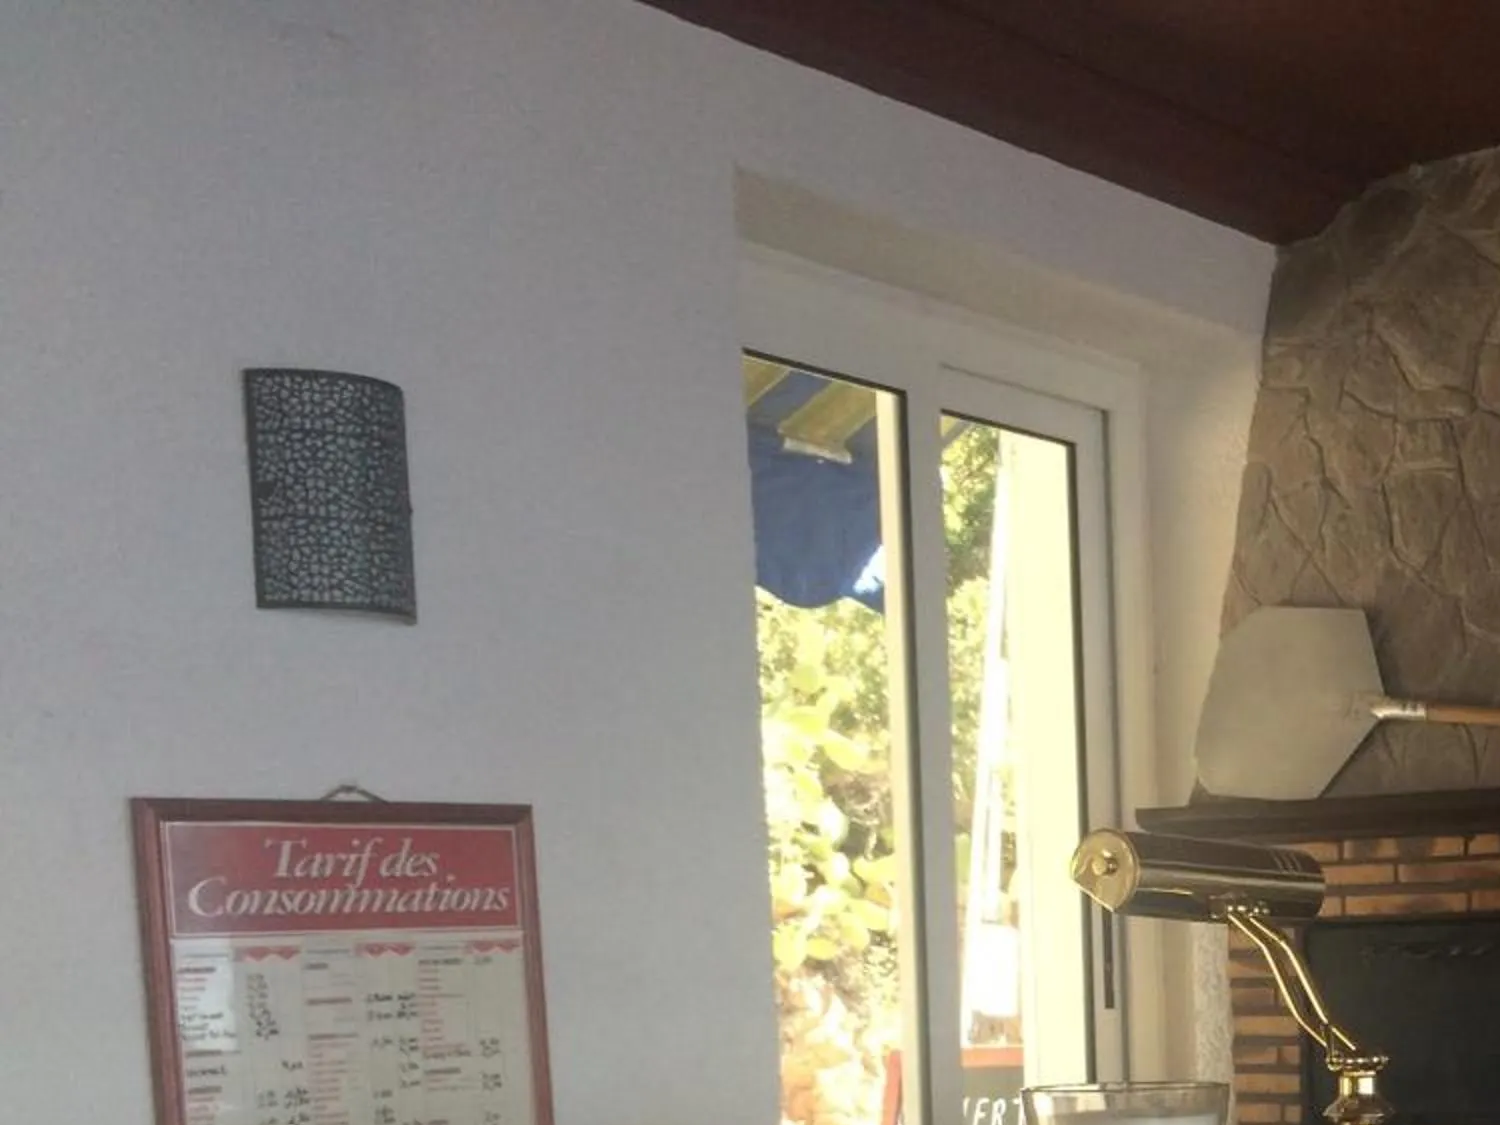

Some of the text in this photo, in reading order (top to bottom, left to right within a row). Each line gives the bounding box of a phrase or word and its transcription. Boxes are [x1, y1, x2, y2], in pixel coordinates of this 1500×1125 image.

[265, 837, 440, 887] Tarif des
[187, 875, 510, 918] Consommations
